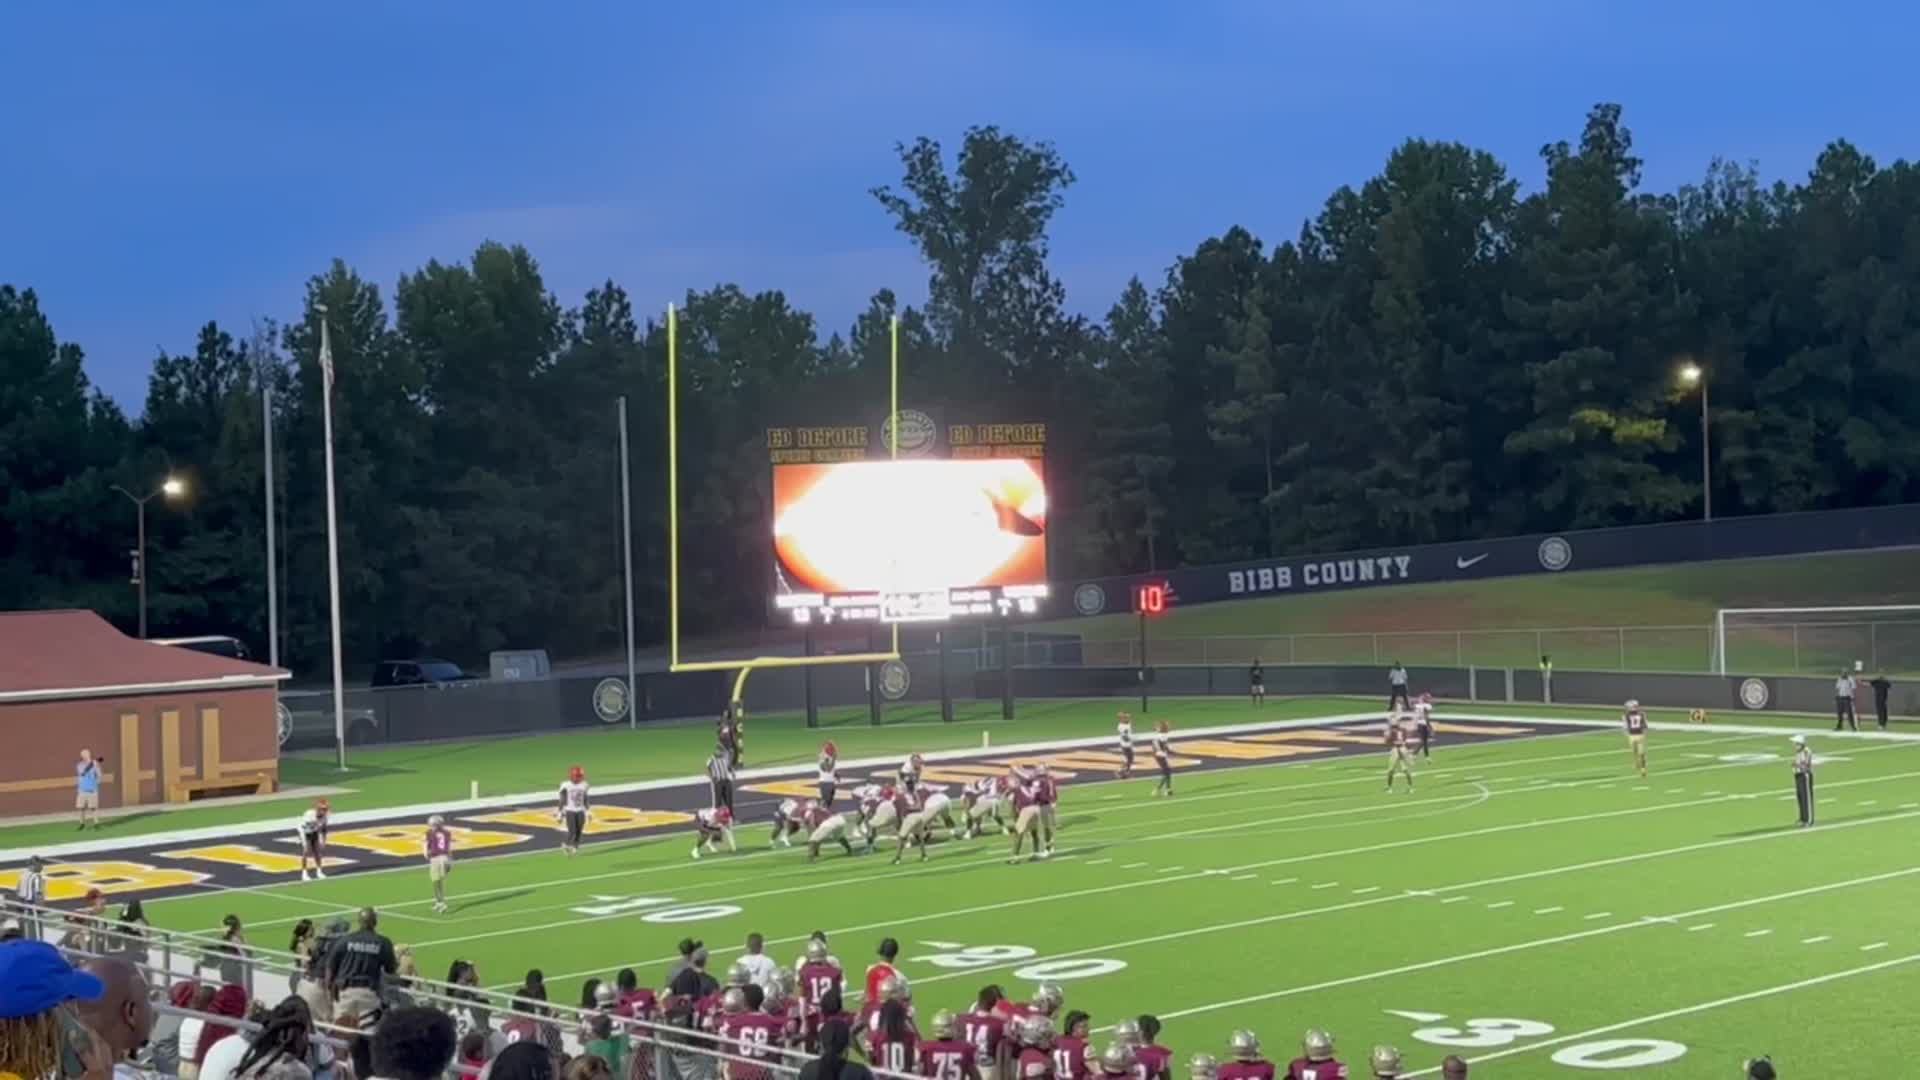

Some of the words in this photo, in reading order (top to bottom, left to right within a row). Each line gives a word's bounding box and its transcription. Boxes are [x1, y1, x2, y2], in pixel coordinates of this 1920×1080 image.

[1228, 566, 1293, 593] BIBB
[1303, 556, 1411, 585] COUNTY
[1140, 586, 1162, 612] 10
